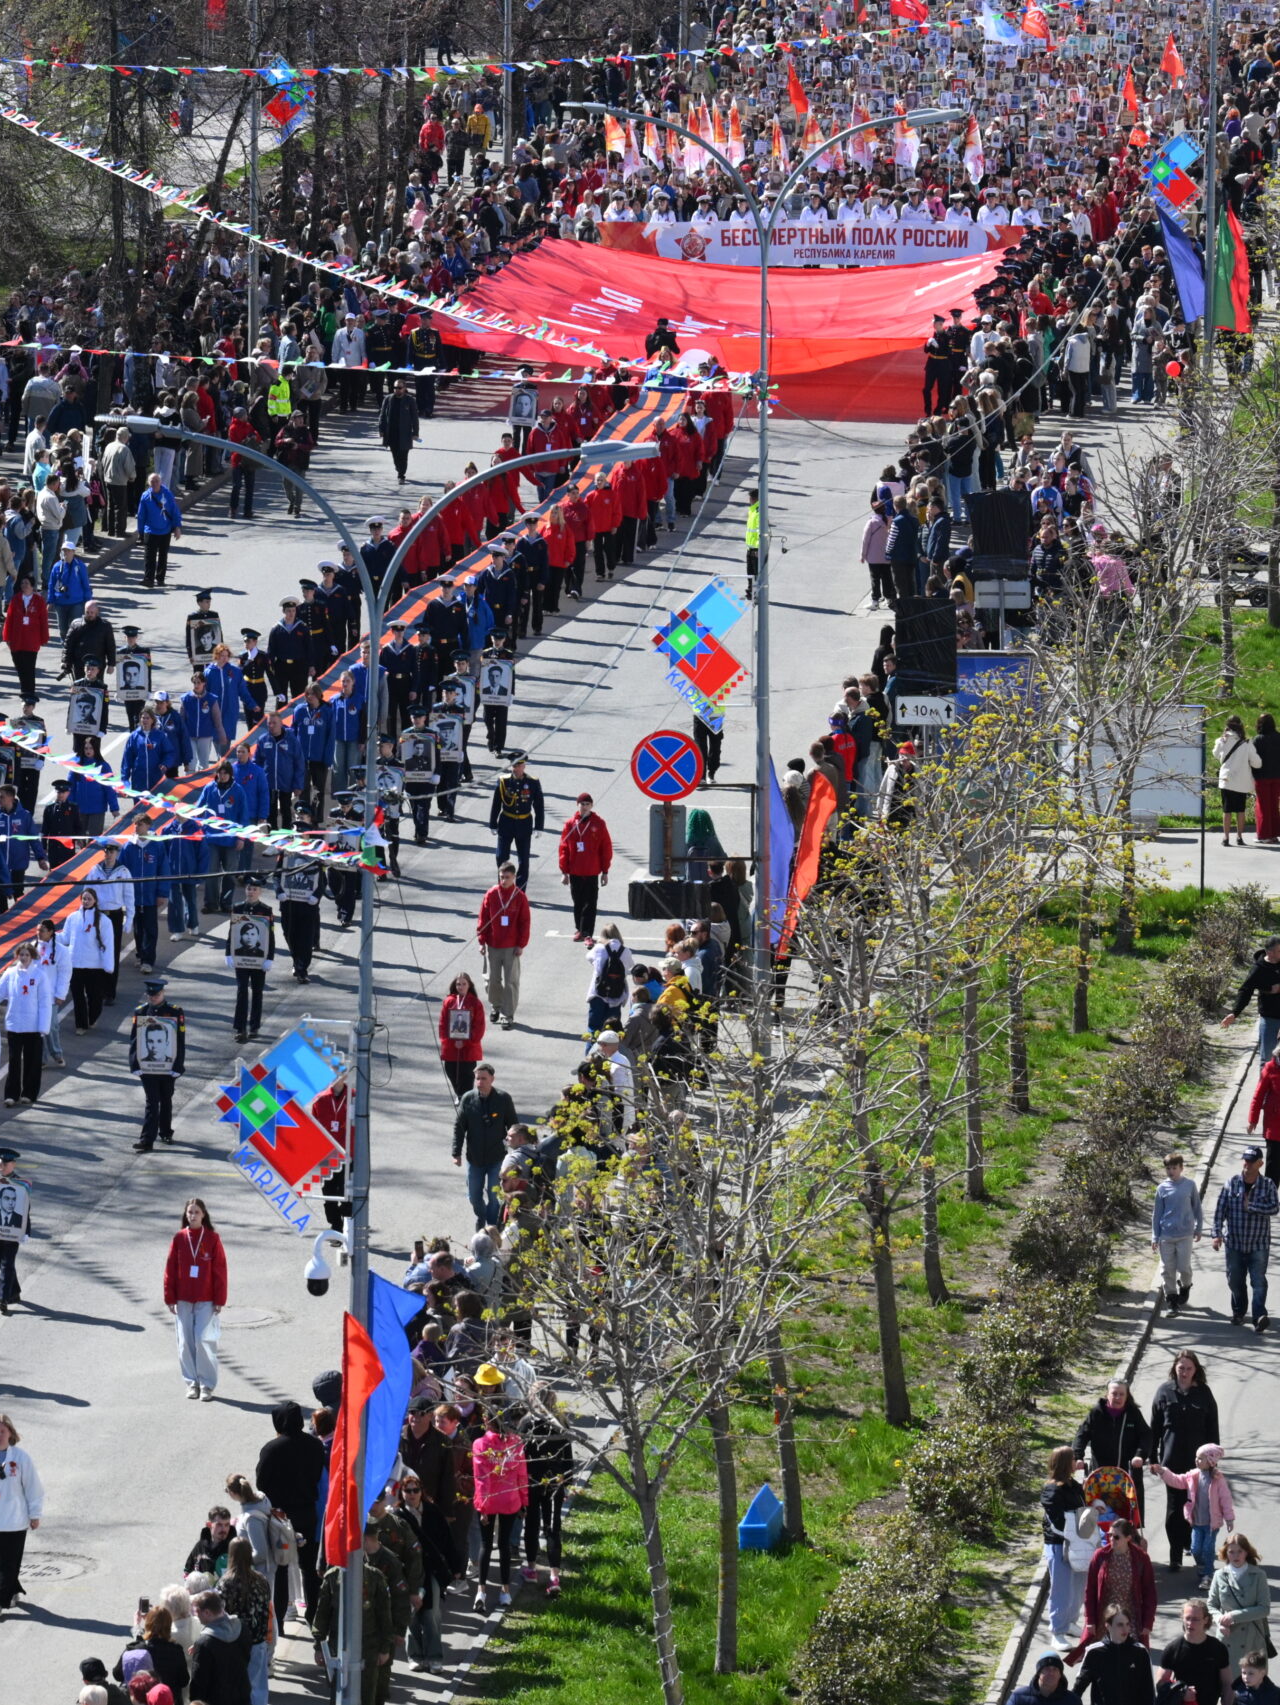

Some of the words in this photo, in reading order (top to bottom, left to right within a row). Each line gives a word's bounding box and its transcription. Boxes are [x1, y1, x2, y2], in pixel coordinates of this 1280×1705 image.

[852, 227, 897, 246] ПОЛК
[902, 228, 969, 248] РОССИИ
[793, 248, 851, 259] РЕСПУБЛИКА
[853, 249, 895, 260] КАРЕЛИЯ
[665, 669, 725, 732] KARJALA
[914, 705, 928, 716] 10
[233, 1145, 312, 1233] KARJALA
